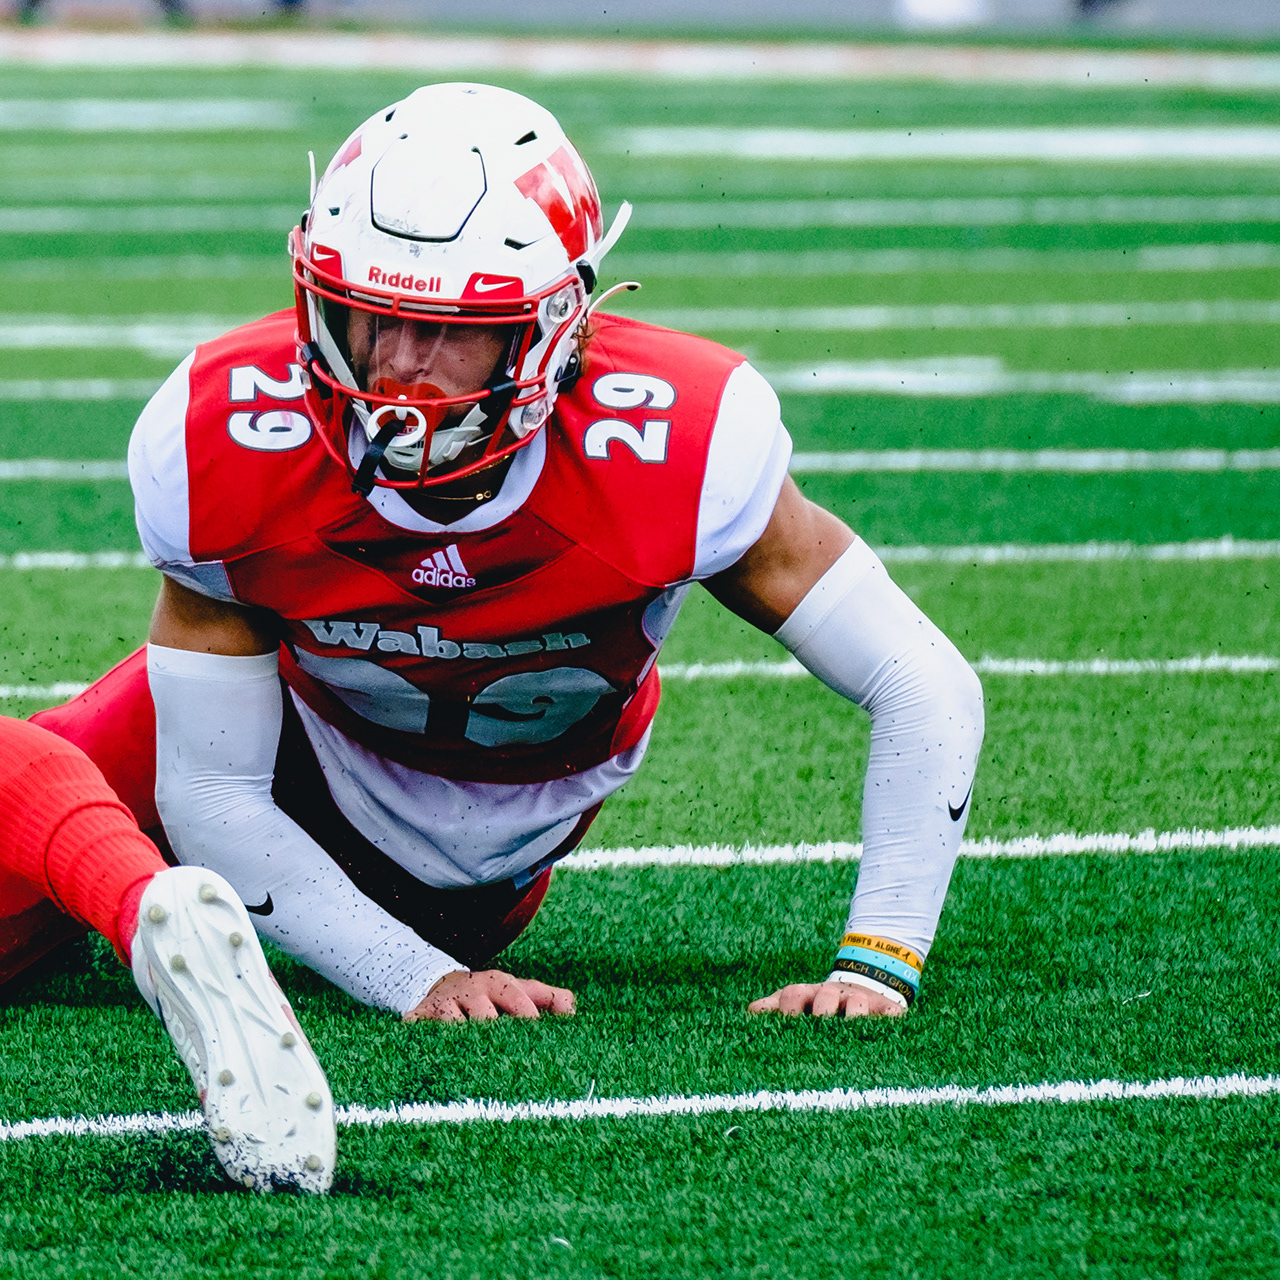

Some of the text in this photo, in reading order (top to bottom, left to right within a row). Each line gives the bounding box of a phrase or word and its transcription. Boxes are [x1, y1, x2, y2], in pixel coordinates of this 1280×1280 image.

[367, 265, 442, 293] Riddell
[227, 363, 314, 452] 29
[583, 372, 677, 464] 29
[411, 567, 477, 588] adidas
[301, 619, 592, 660] Wabash
